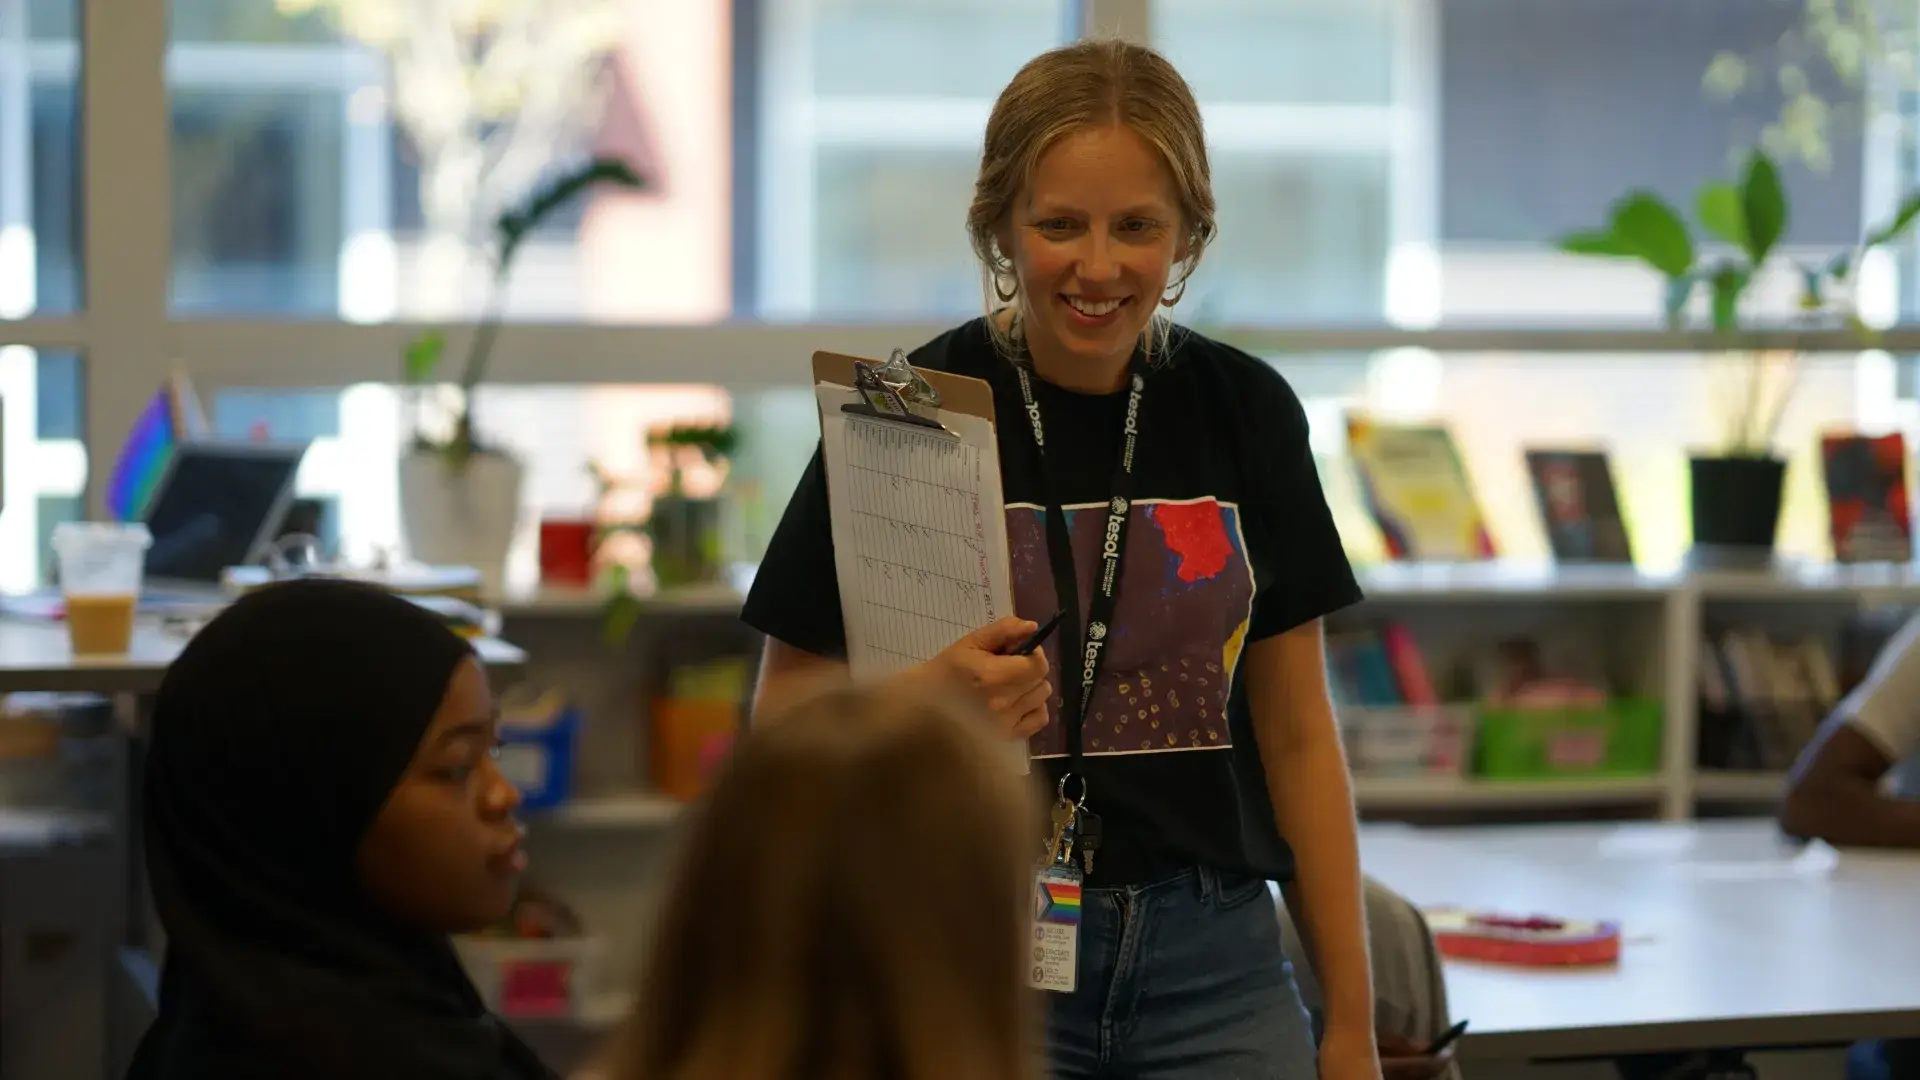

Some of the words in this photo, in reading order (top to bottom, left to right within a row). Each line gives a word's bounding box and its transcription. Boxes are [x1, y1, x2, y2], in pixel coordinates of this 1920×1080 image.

[1124, 391, 1142, 435] tesol
[1103, 514, 1124, 560] tesol
[1082, 641, 1102, 688] tesol
